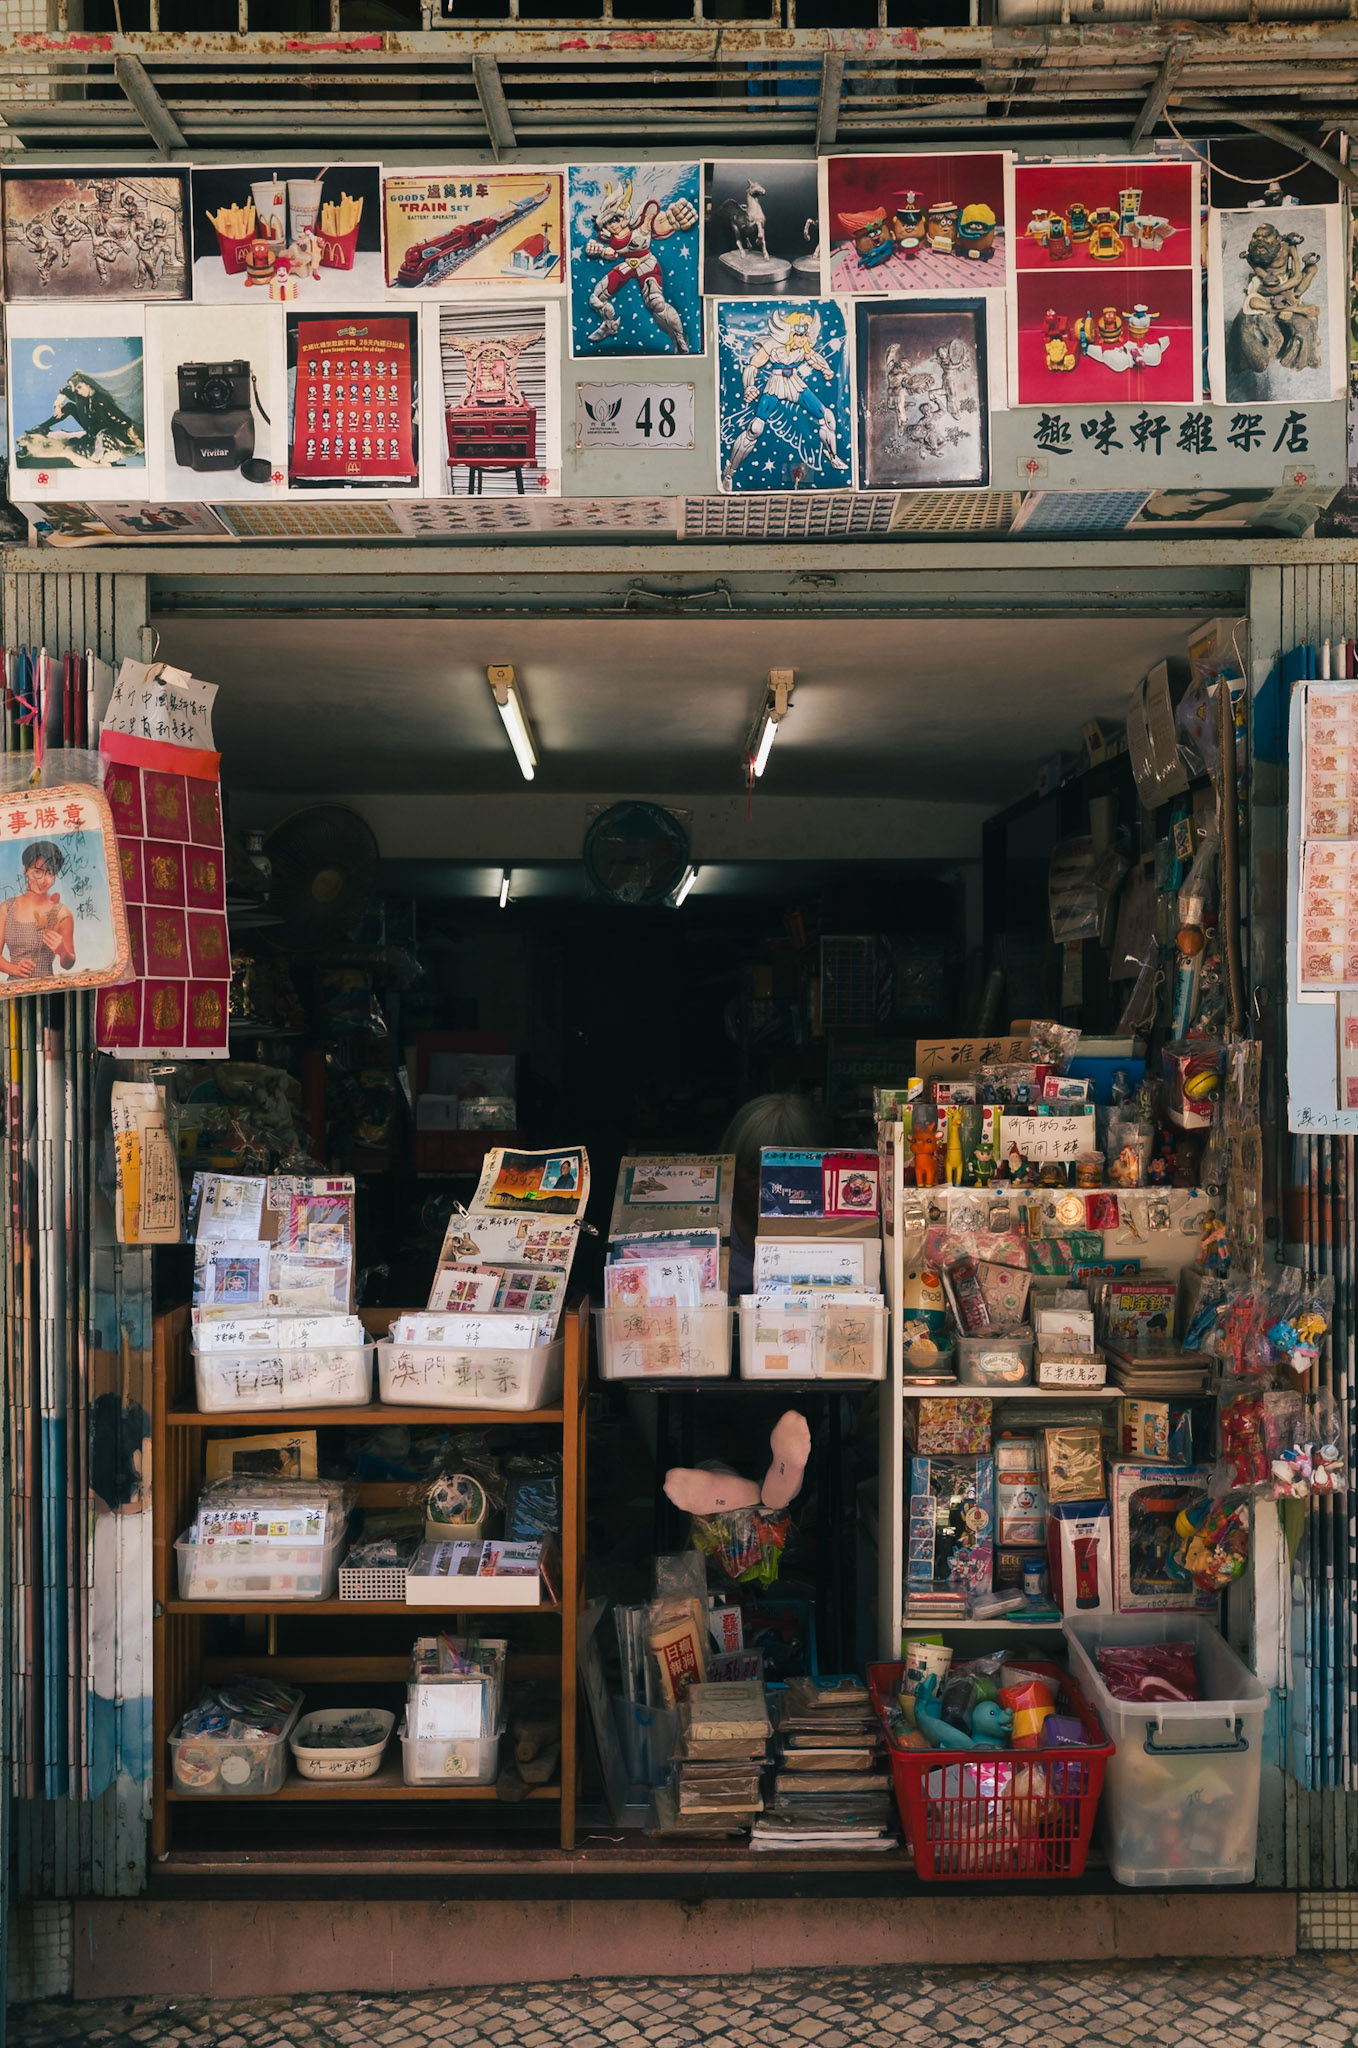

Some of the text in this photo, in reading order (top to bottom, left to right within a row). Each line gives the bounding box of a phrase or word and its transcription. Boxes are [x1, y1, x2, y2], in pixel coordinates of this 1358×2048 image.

[390, 194, 425, 202] GOODS
[399, 203, 447, 213] TRAIN
[635, 397, 676, 438] 48
[1033, 410, 1310, 455] 趣味軒雜架店
[200, 449, 229, 457] Vivitar
[0, 803, 86, 837] 事勝意
[1008, 1118, 1078, 1136] 所有物品
[503, 1175, 536, 1187] 1997
[771, 1184, 792, 1197] 澳門
